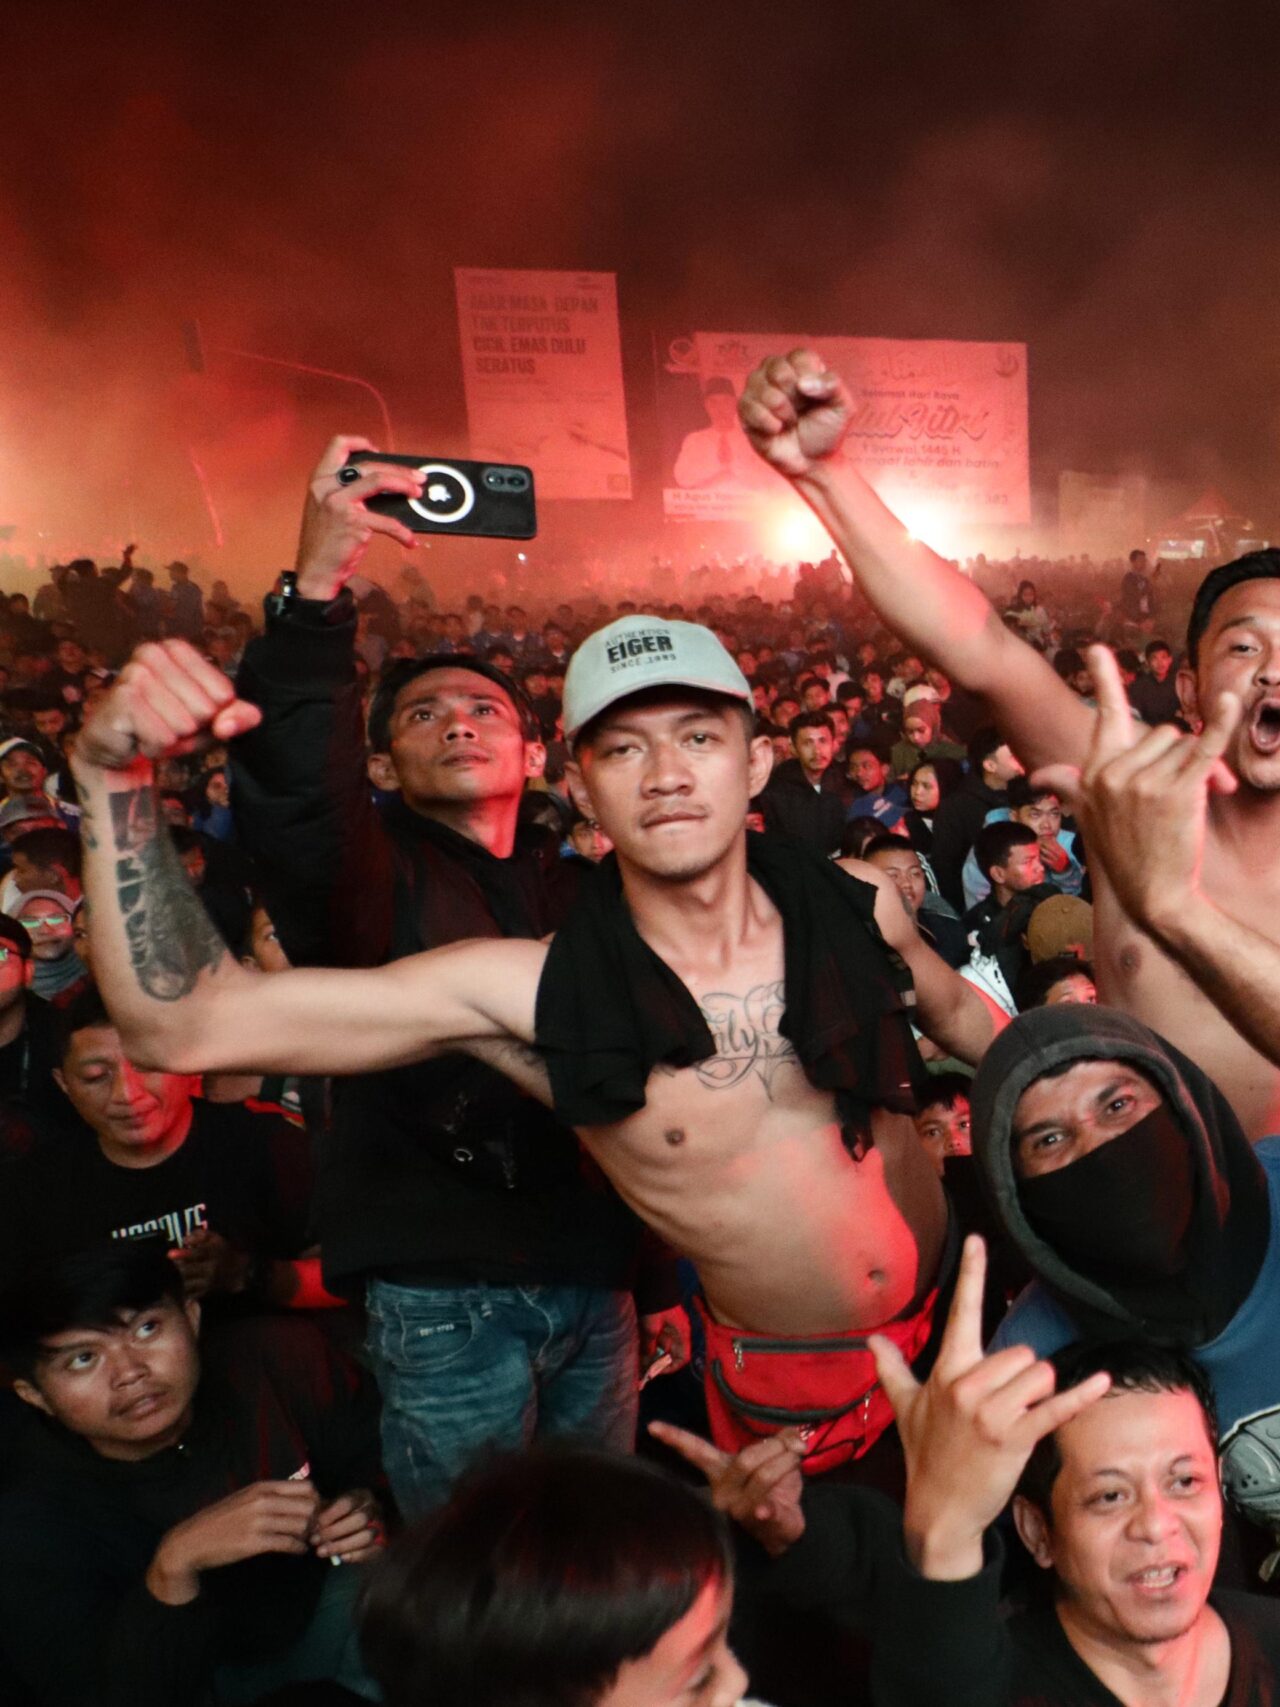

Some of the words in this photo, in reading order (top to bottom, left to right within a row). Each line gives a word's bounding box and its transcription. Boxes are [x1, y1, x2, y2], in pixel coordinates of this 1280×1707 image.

[511, 337, 548, 353] EMAS
[550, 338, 587, 355] DULU
[475, 357, 536, 375] SERATUS
[607, 636, 673, 663] EIGER
[611, 657, 641, 673] SINCE
